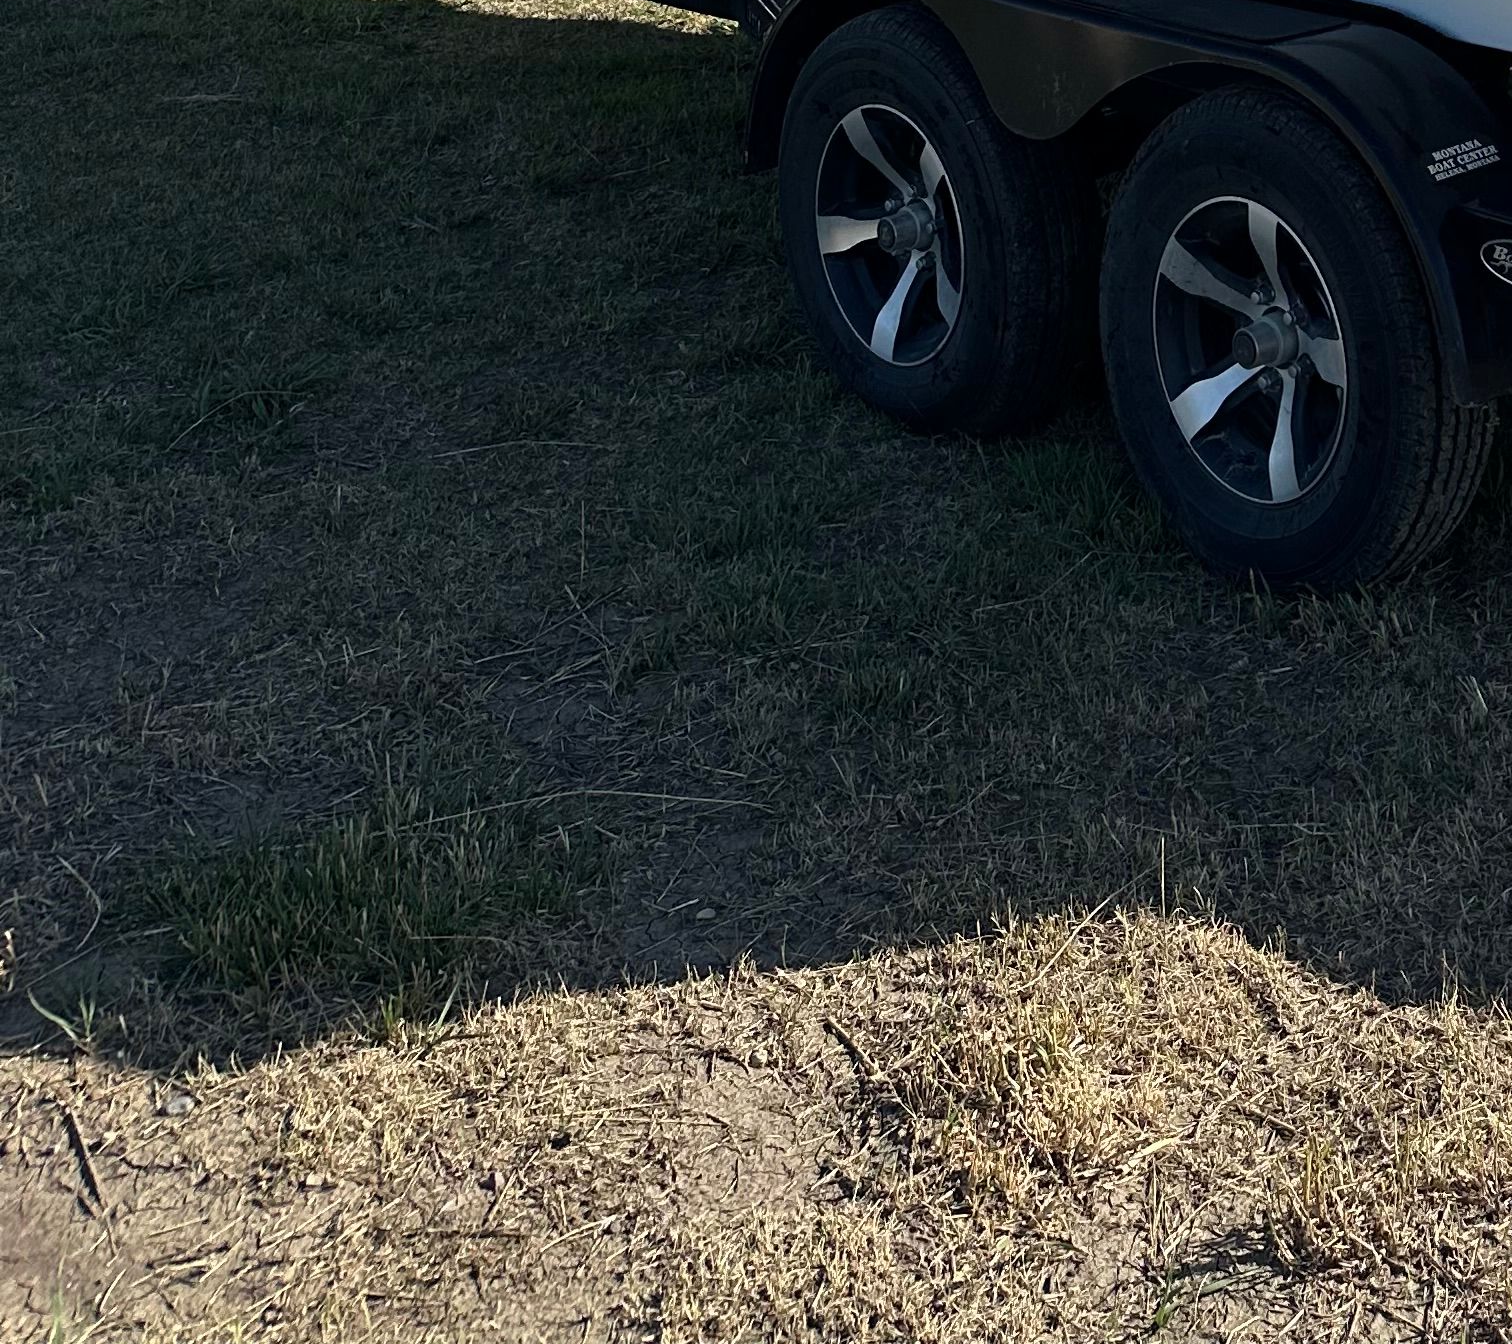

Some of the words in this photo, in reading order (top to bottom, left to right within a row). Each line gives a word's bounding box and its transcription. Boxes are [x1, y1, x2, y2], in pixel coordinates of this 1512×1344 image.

[1427, 158, 1456, 175] BOAT
[1456, 144, 1499, 165] CENTER
[1432, 139, 1482, 161] MONTANA
